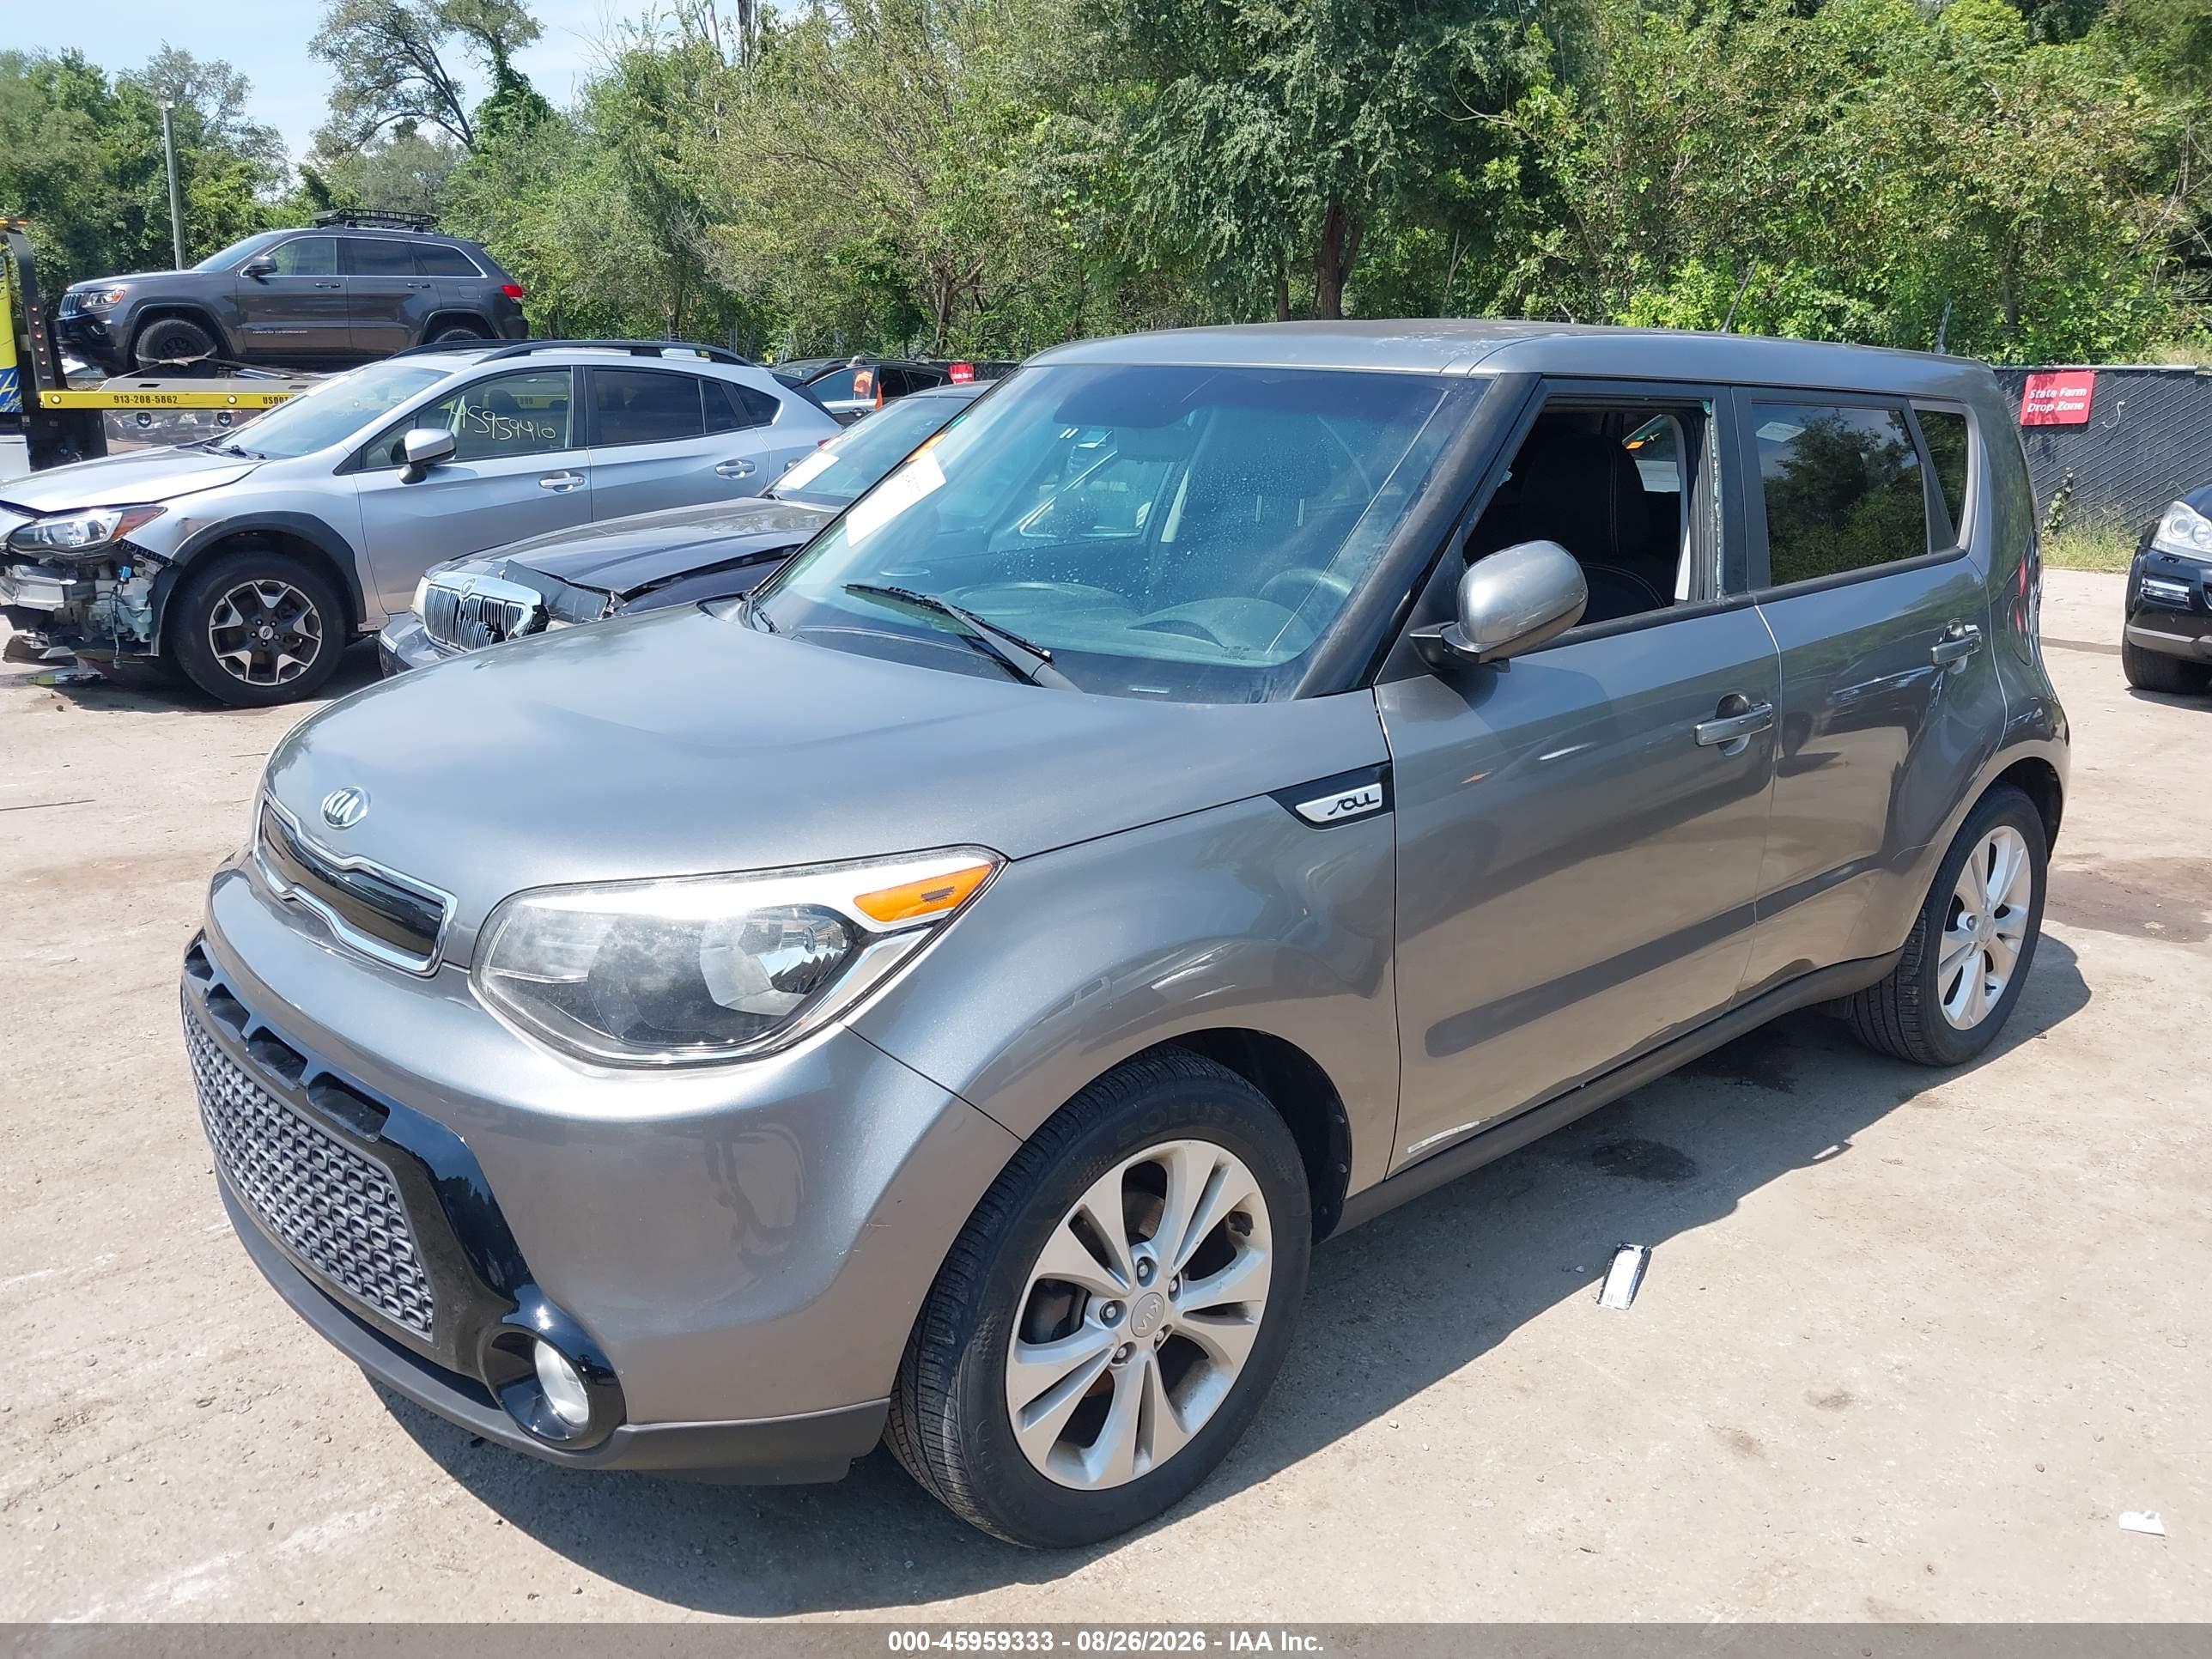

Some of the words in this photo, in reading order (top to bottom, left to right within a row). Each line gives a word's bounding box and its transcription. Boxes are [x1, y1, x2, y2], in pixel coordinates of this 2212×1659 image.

[113, 395, 179, 404] 913-208-5862
[2028, 389, 2058, 399] State
[2059, 387, 2087, 398] Farm
[2027, 403, 2055, 414] Drop
[2056, 401, 2085, 411] Zone
[450, 396, 556, 442] 45959410
[1137, 1297, 1162, 1330] KIA
